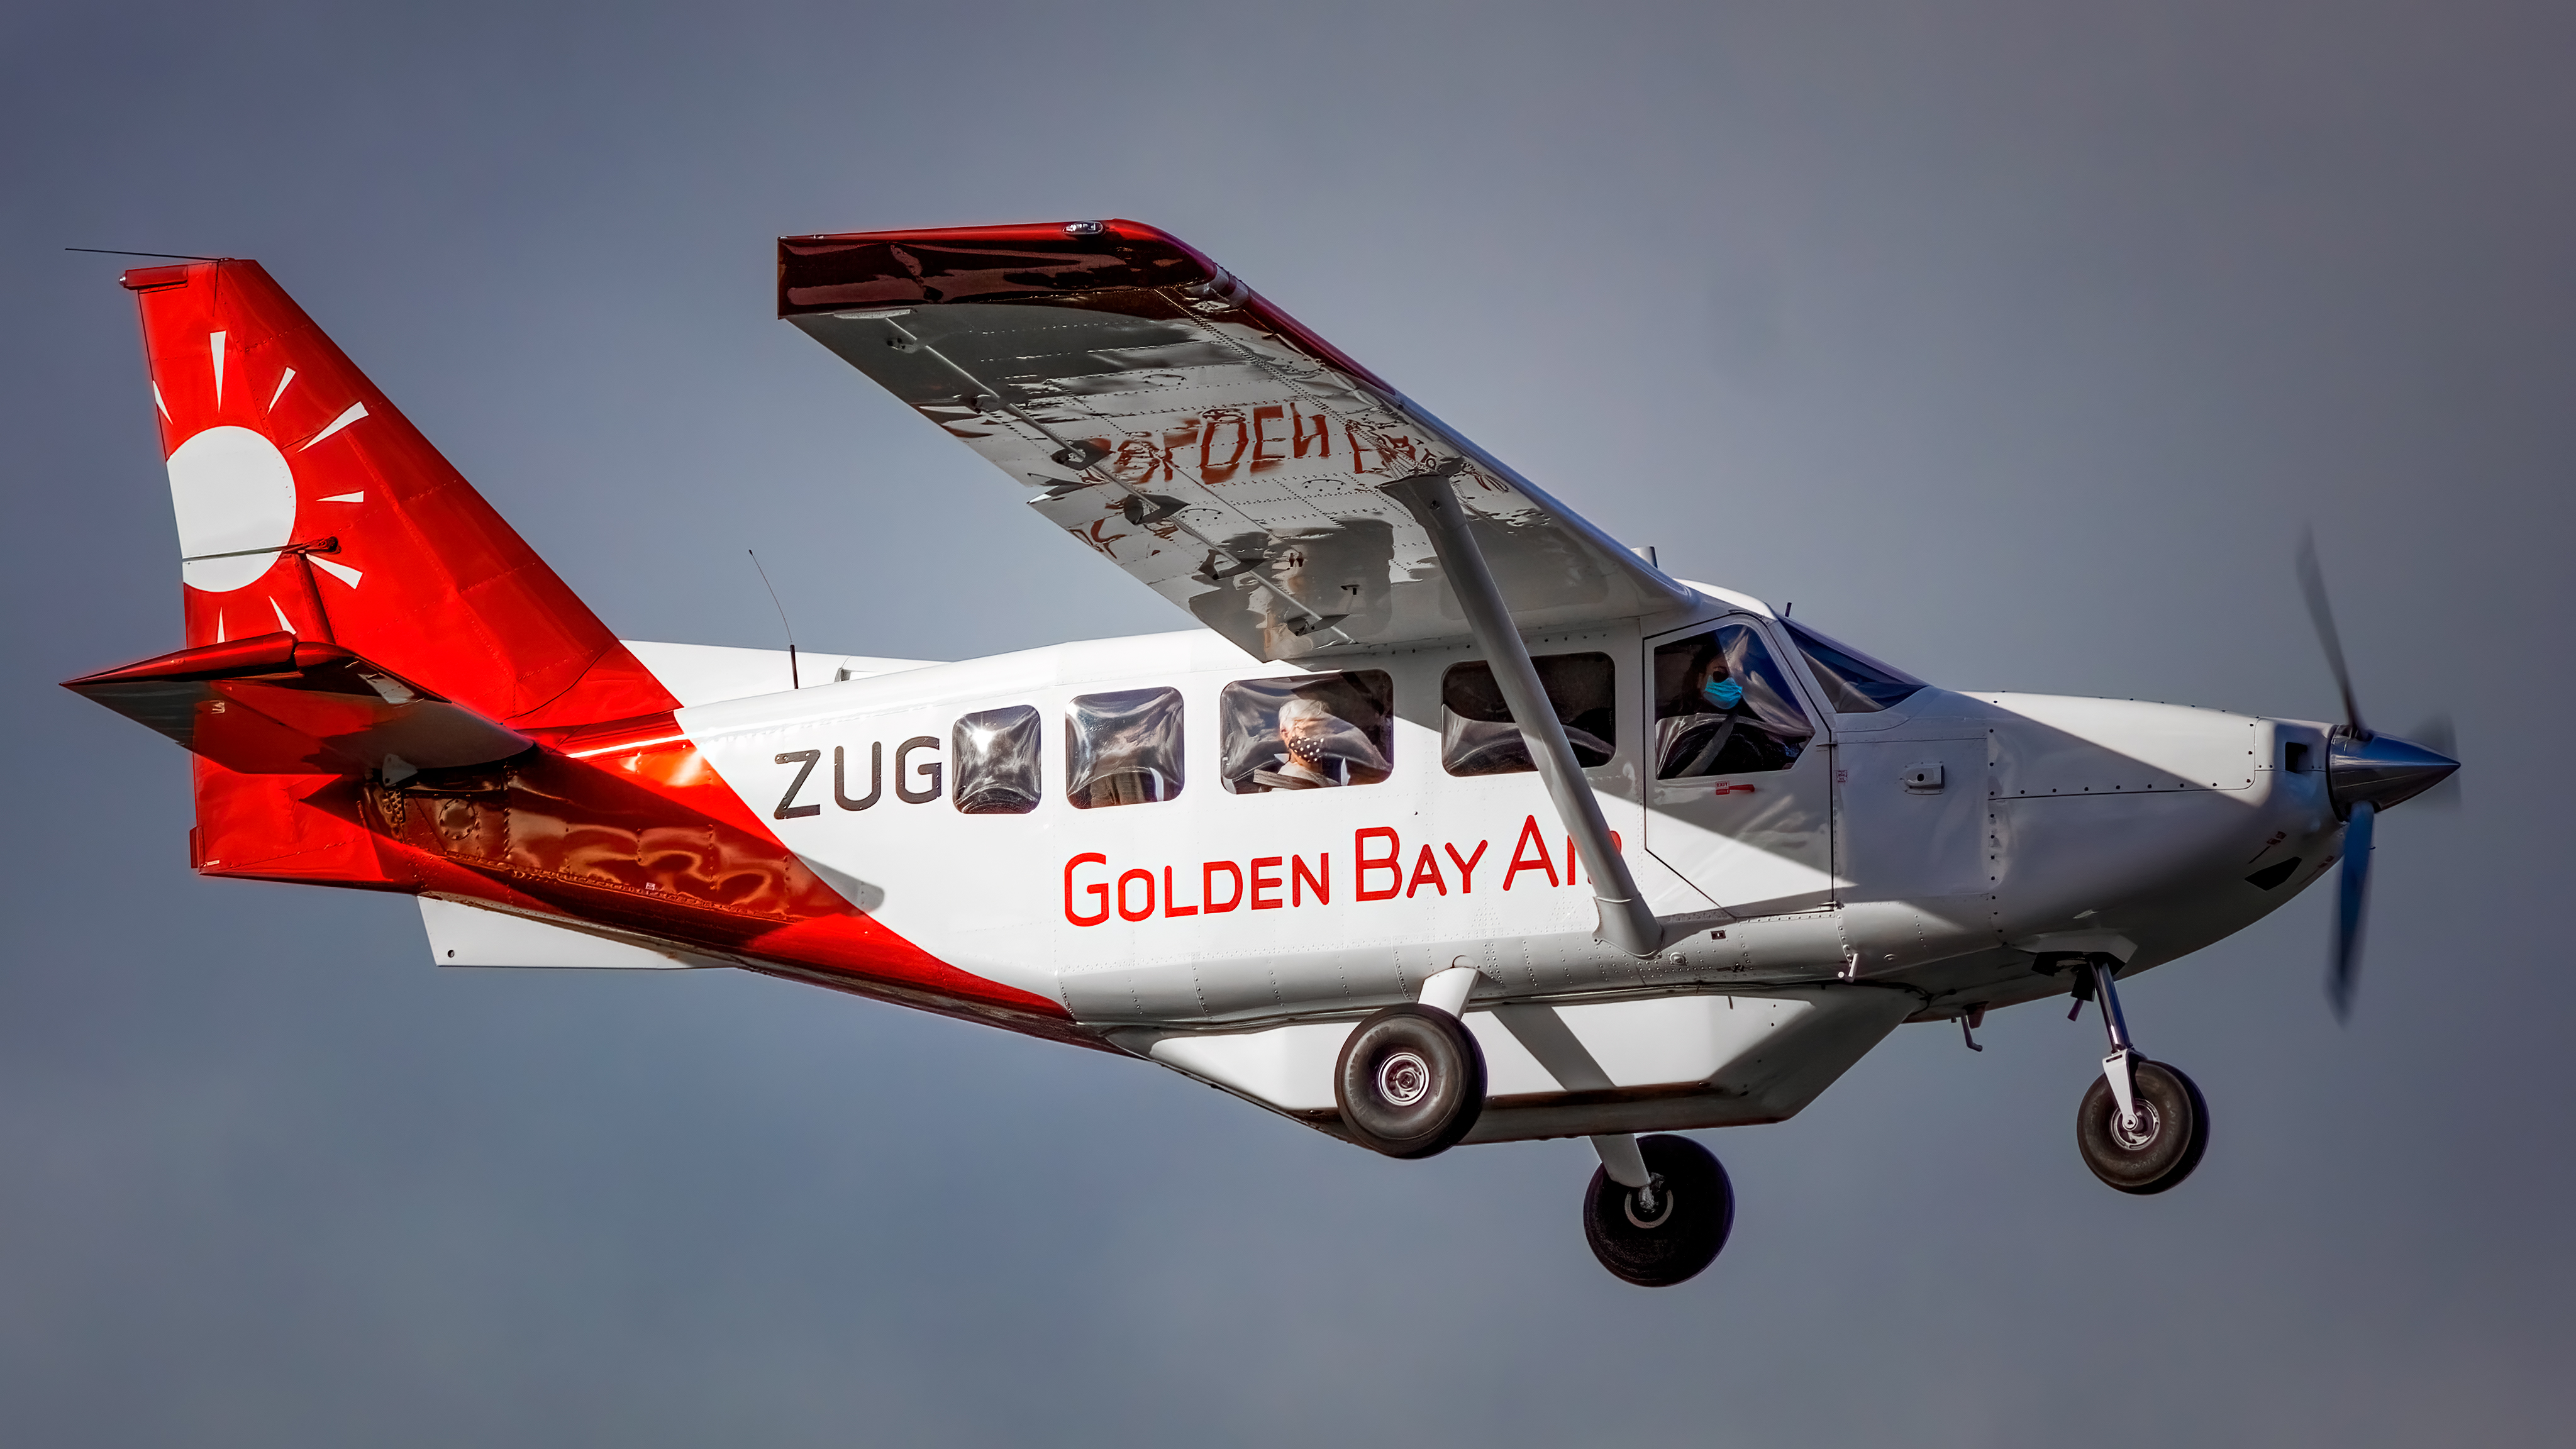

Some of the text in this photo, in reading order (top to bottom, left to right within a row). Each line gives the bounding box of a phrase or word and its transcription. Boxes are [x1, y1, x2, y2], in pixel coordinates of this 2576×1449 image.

[774, 736, 942, 819] ZUG
[1063, 815, 1622, 927] GOLDEN BAY AI
